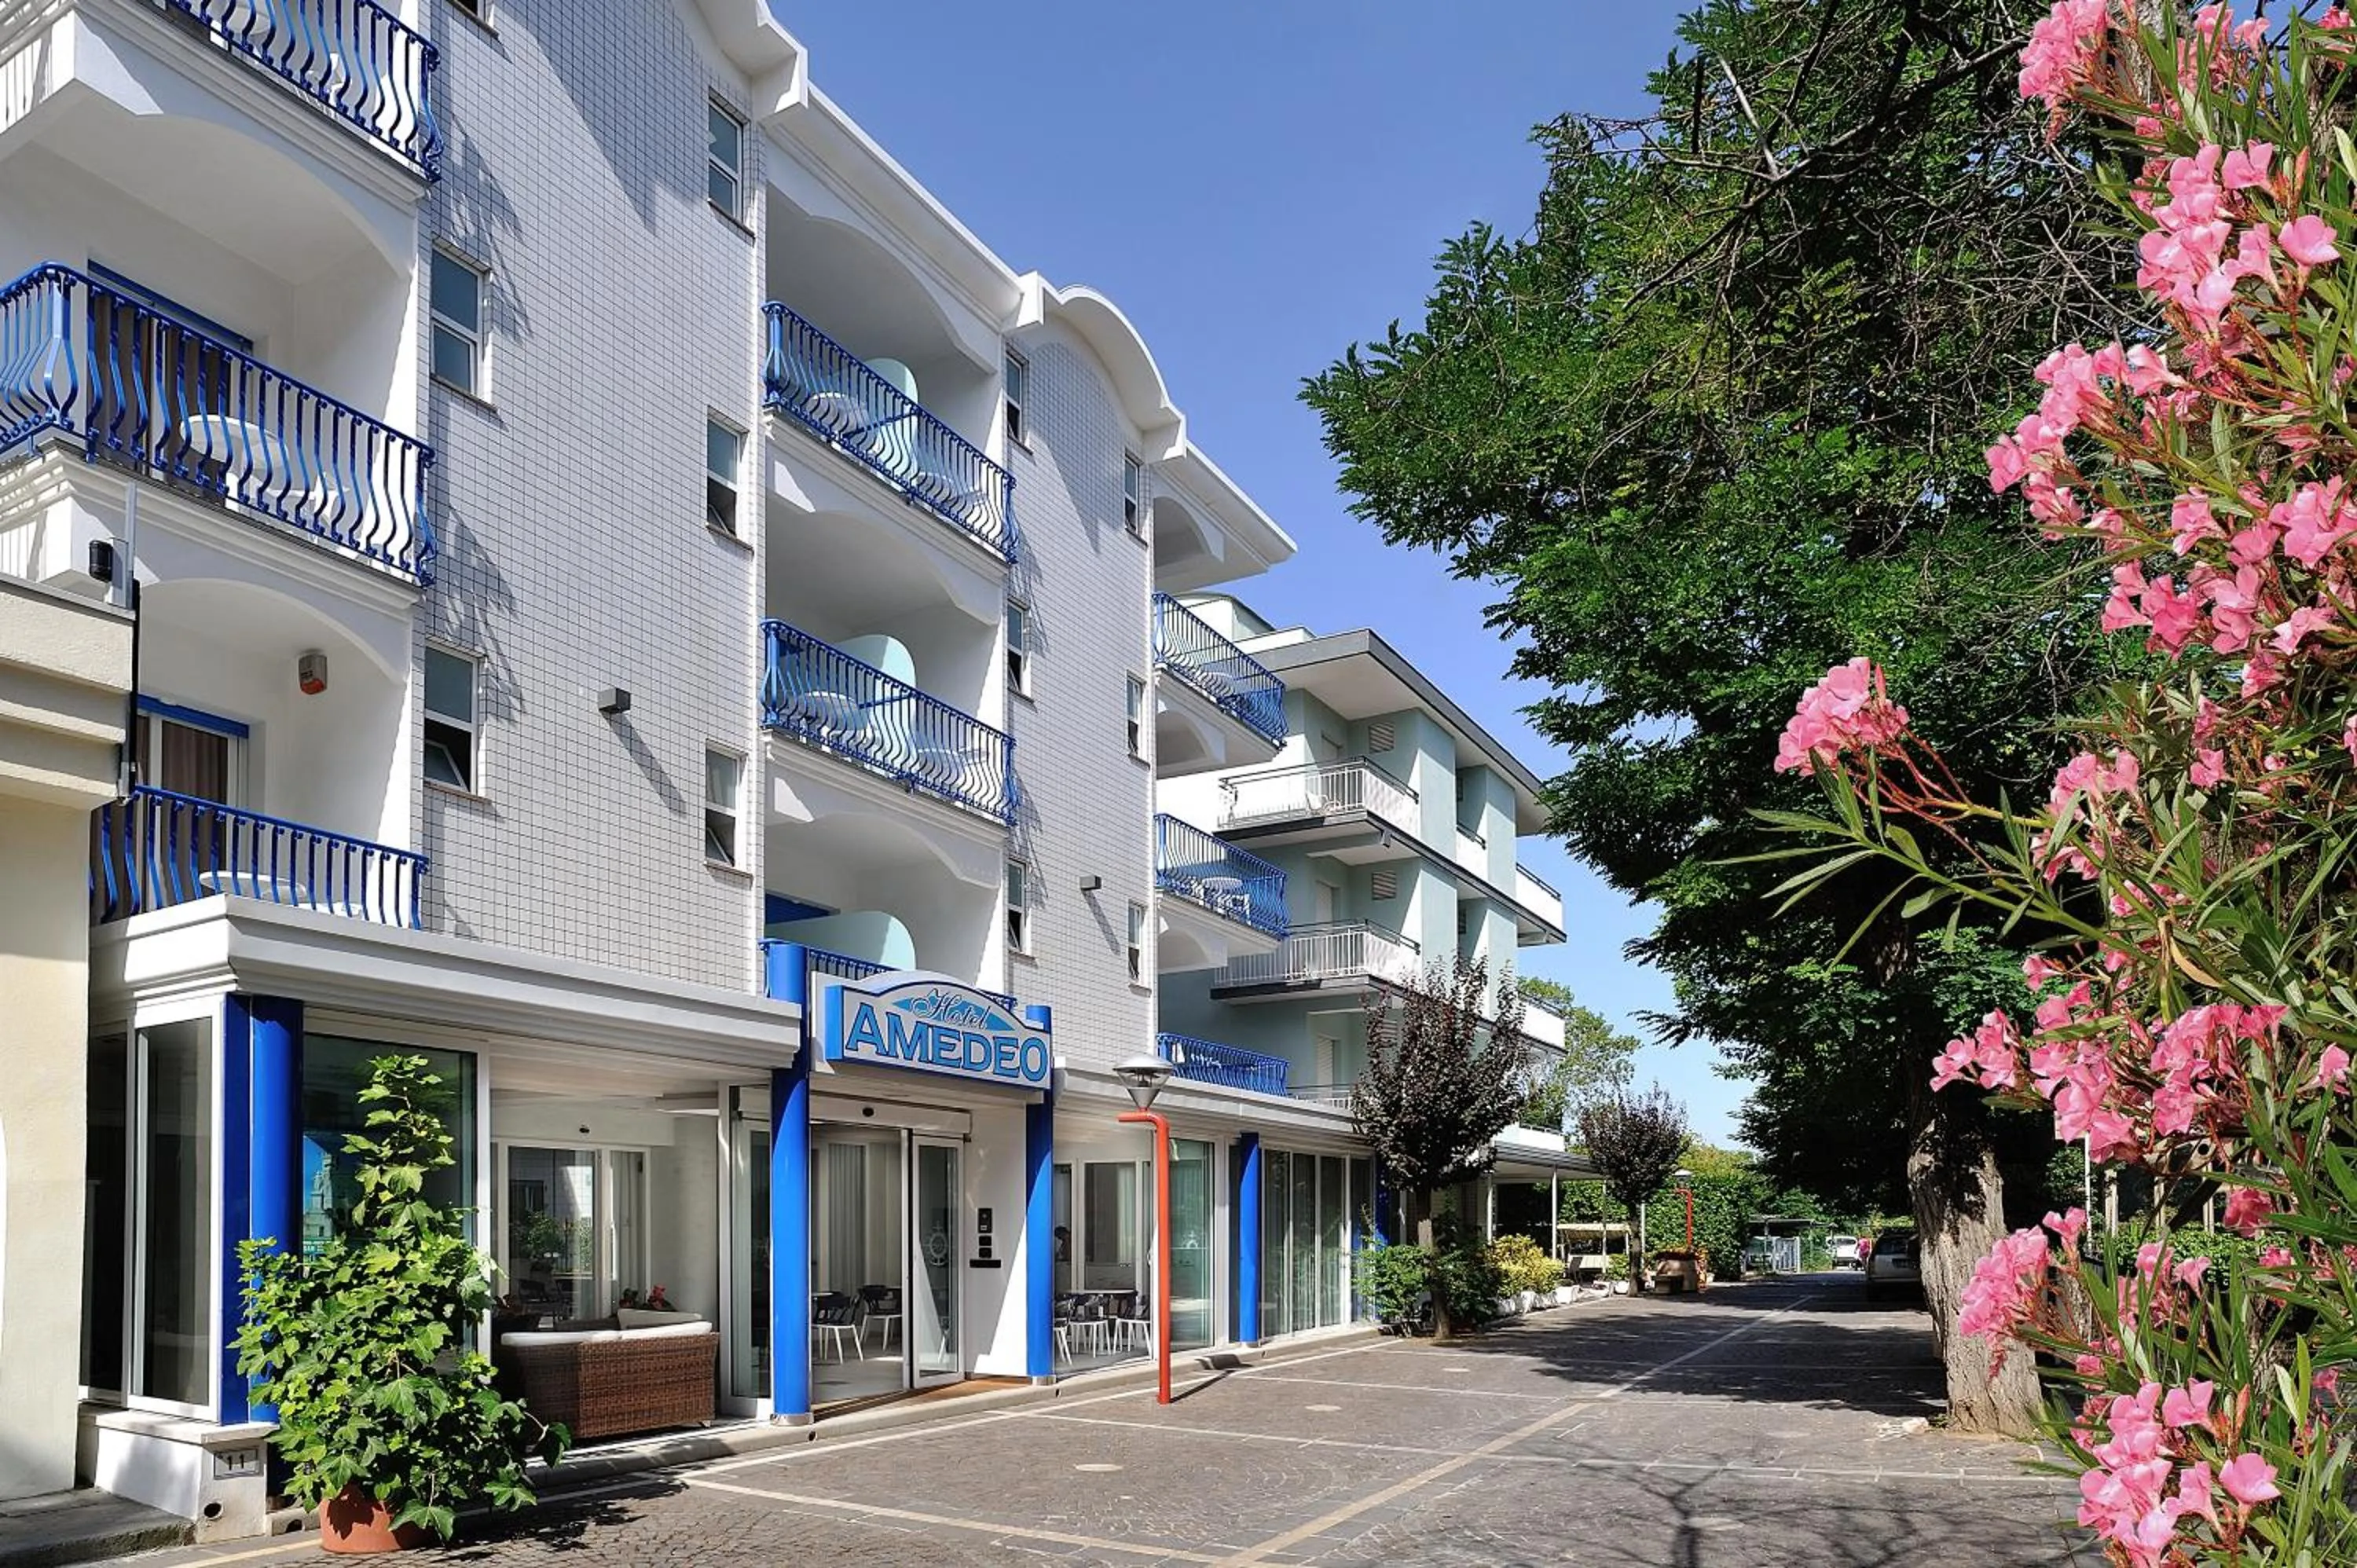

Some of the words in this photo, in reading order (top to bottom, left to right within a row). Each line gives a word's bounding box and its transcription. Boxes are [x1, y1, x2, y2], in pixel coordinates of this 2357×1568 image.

[911, 987, 991, 1030] Hotel
[845, 1002, 1048, 1083] AMEDEO
[226, 1453, 245, 1471] 11
